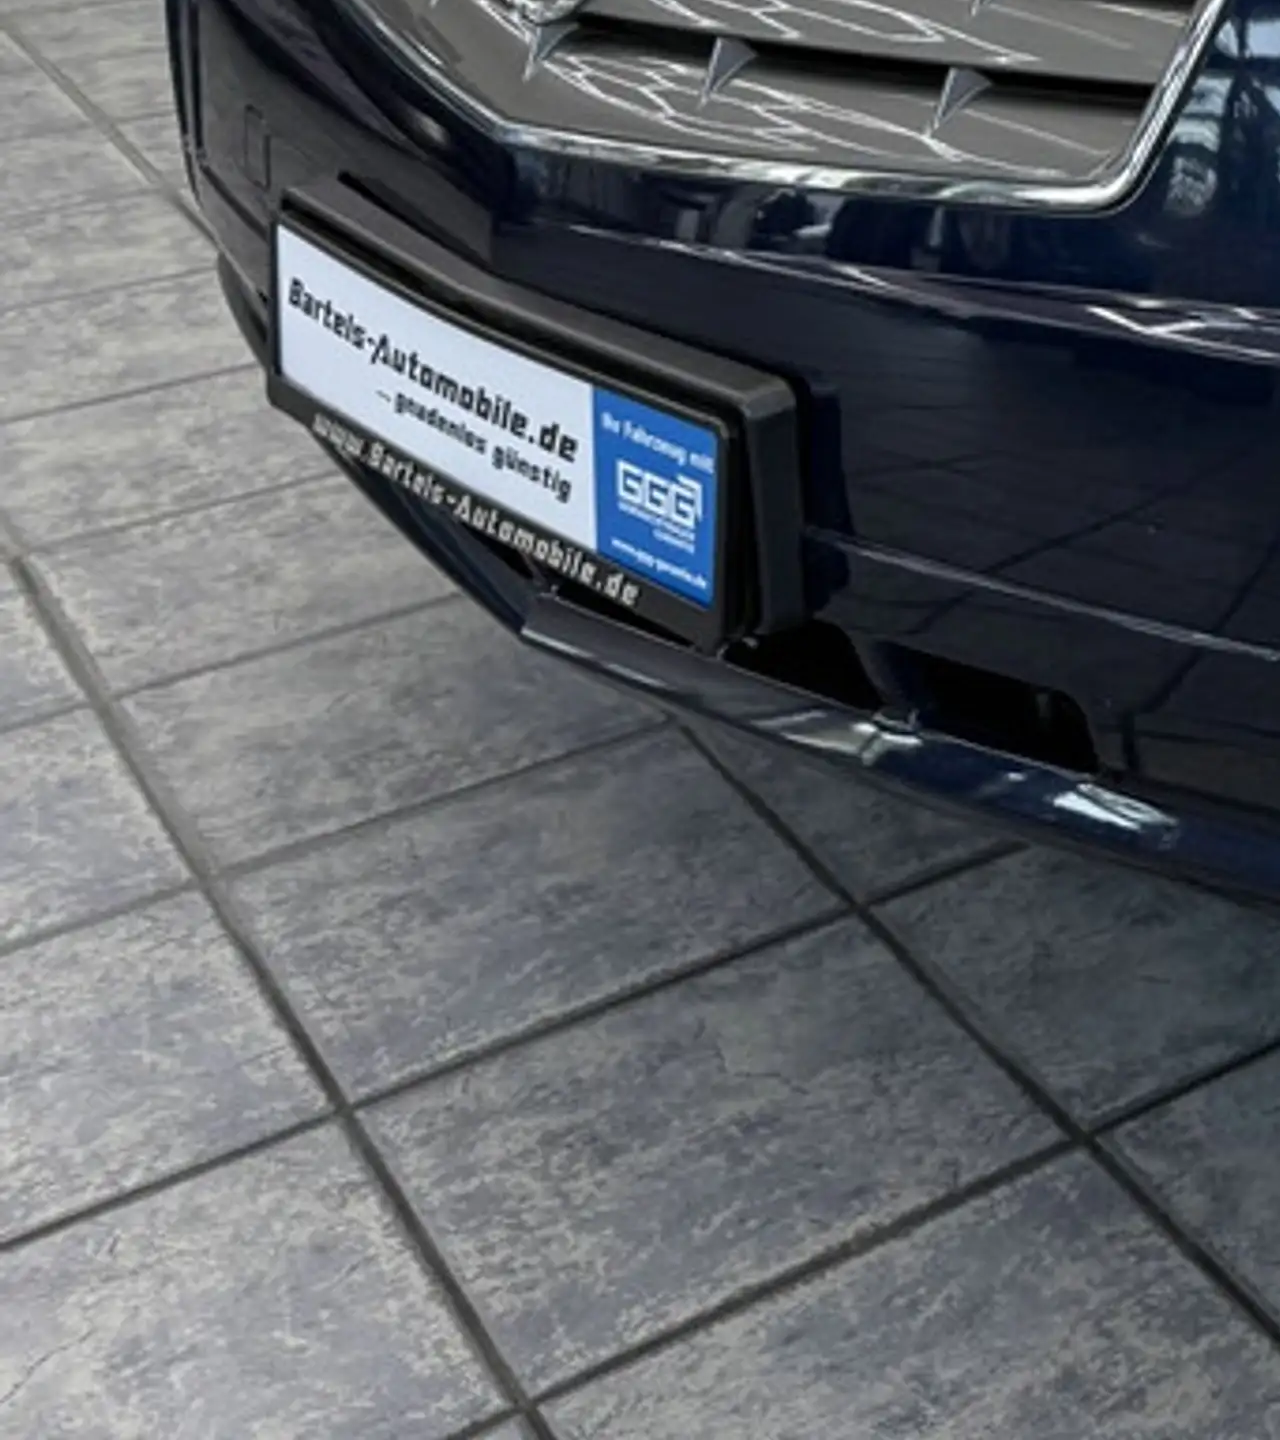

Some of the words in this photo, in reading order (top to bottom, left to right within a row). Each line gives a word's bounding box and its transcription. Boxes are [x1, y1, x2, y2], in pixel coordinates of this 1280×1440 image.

[287, 276, 579, 463] Bartels-Automobile.de
[393, 392, 489, 456] gnadenlos
[490, 444, 573, 504] günstig
